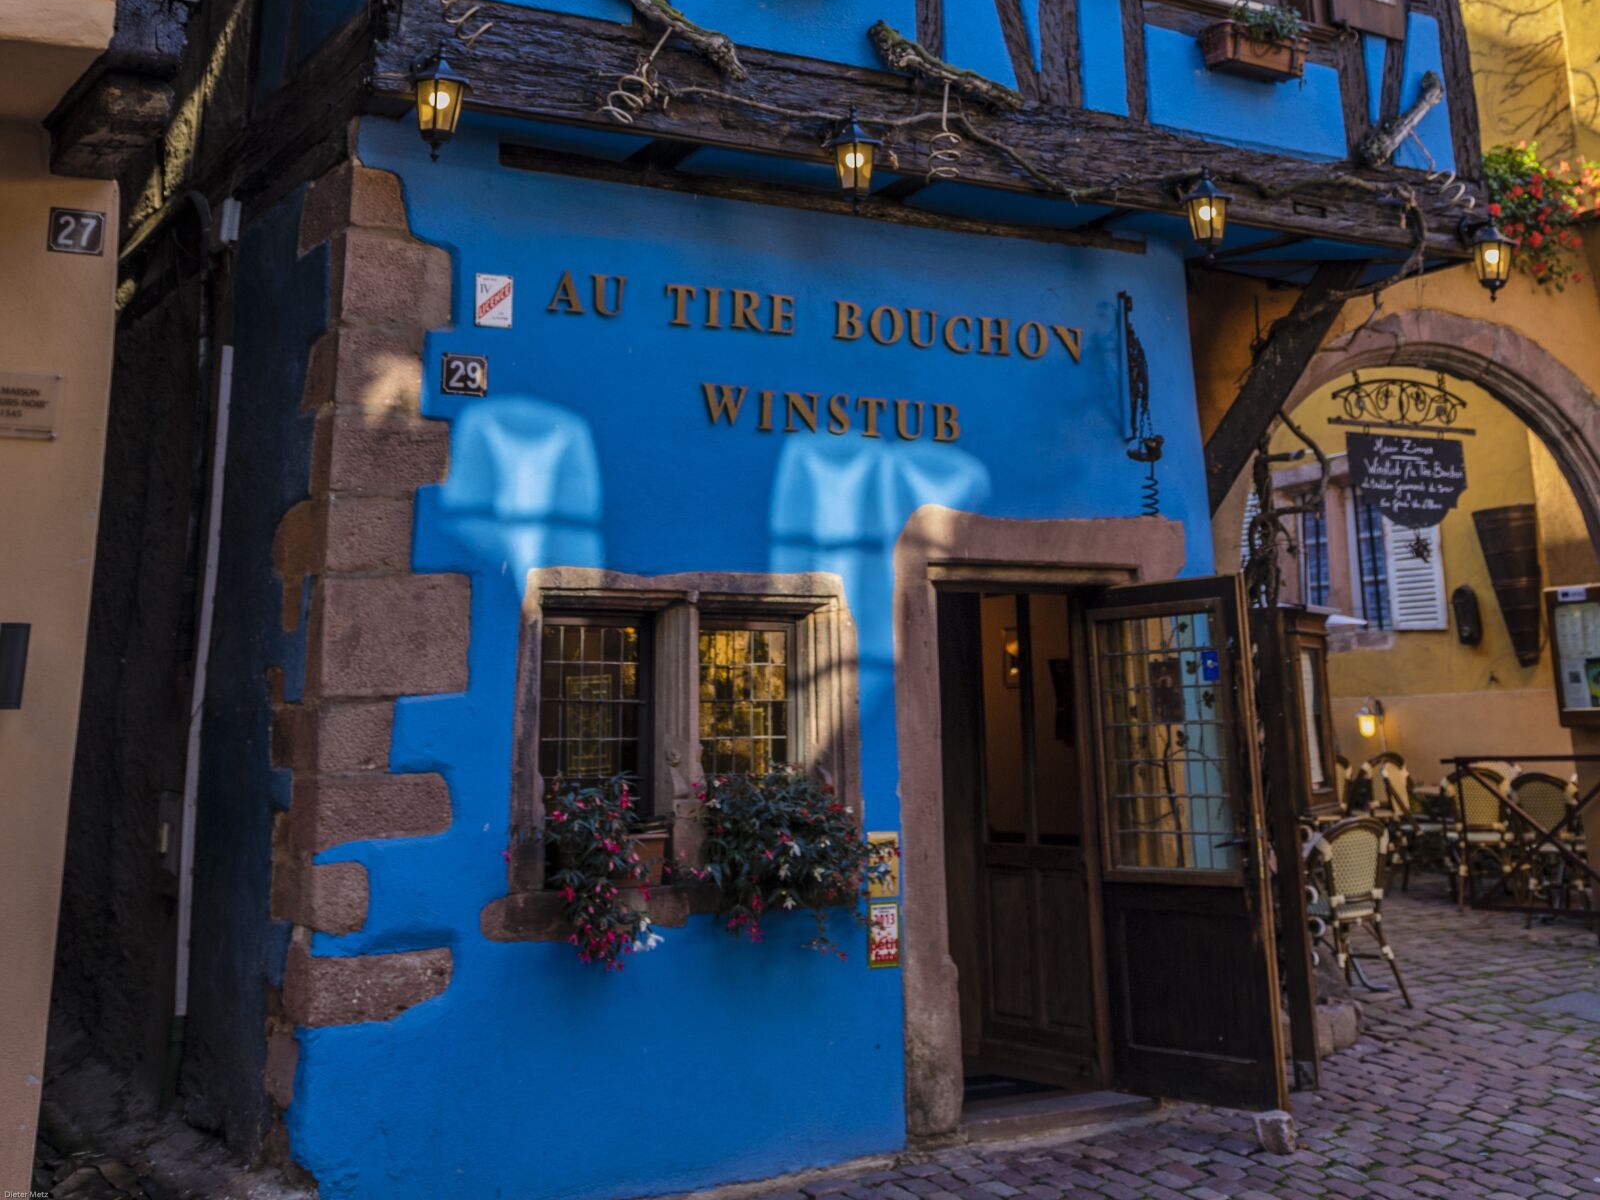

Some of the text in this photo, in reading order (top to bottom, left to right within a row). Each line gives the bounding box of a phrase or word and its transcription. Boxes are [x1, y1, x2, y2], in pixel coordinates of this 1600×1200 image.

[58, 215, 98, 247] 27
[546, 269, 1083, 365] AU TIRE BOUCHON
[449, 360, 481, 389] 29
[702, 383, 961, 442] WINSTUB
